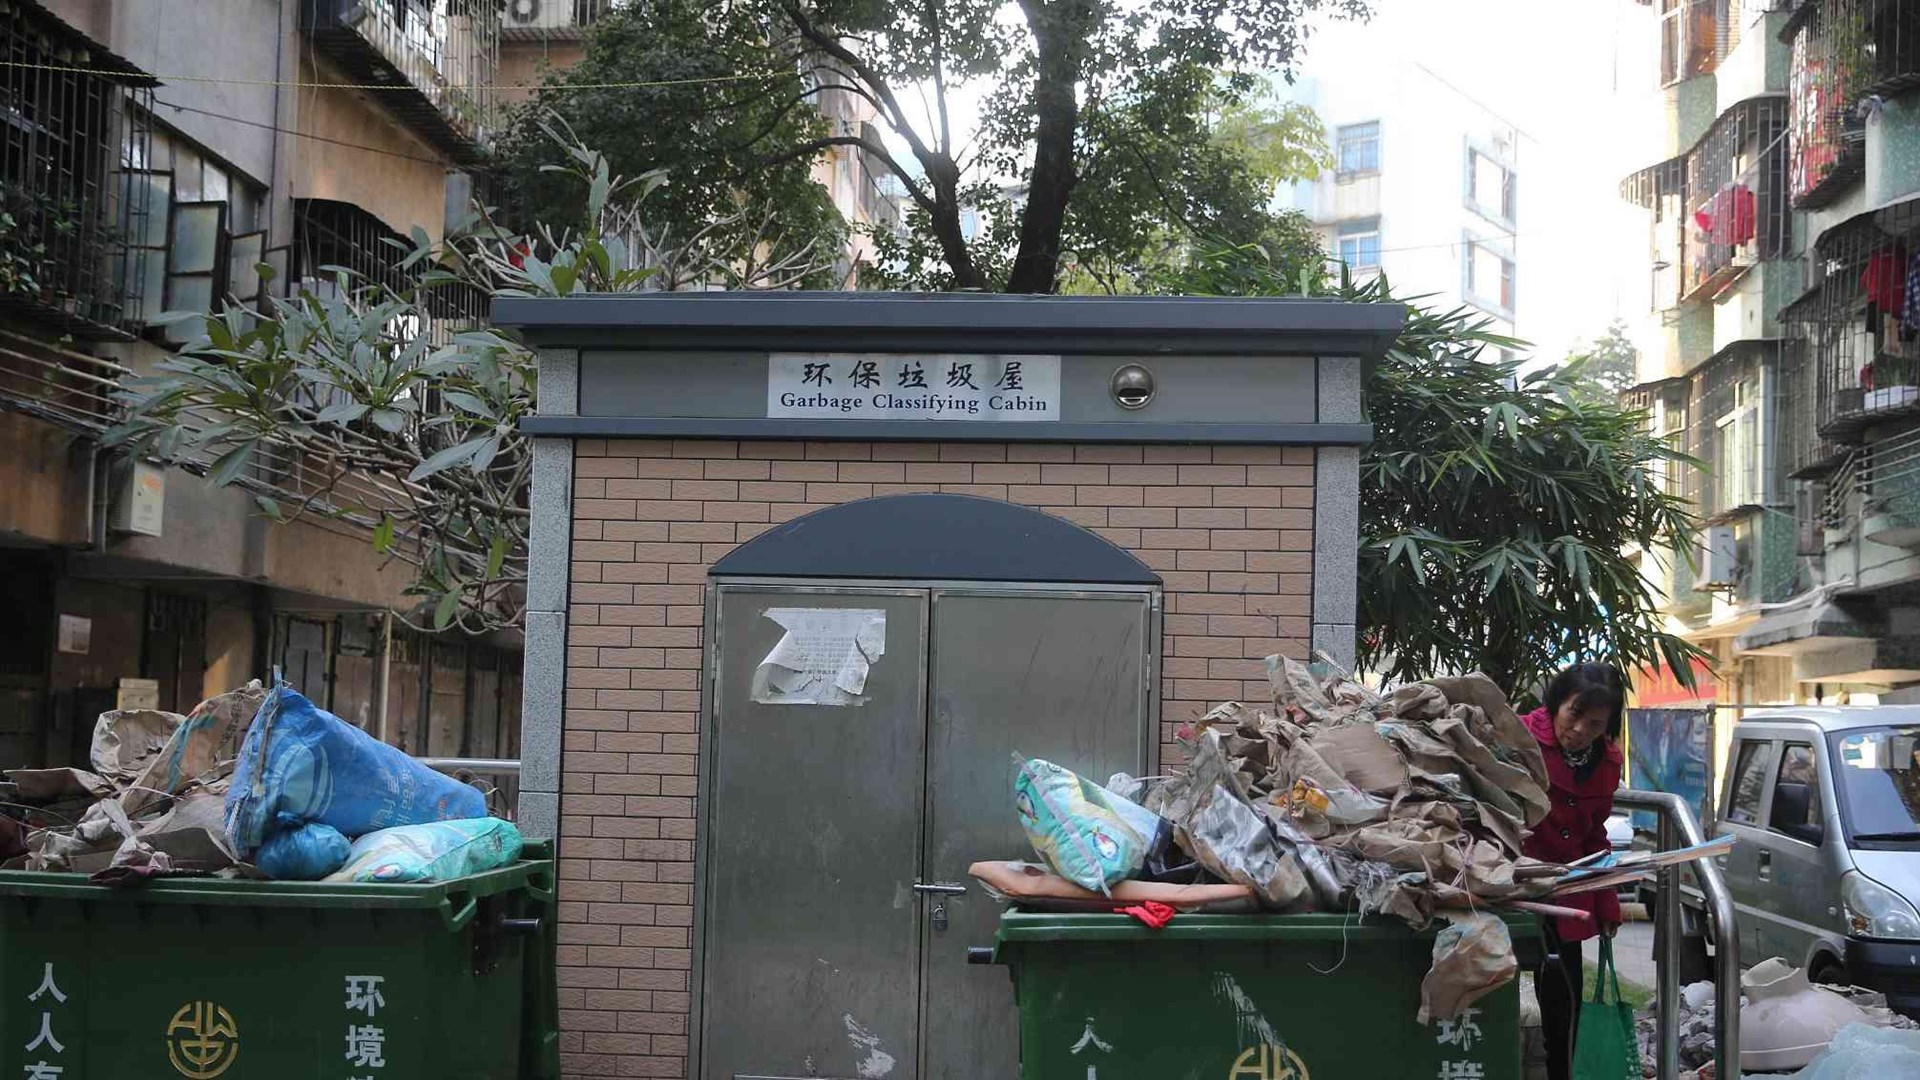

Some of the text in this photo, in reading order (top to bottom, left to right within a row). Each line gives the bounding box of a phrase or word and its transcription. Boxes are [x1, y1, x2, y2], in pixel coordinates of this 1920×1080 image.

[801, 360, 1024, 390] 环保垃圾屋
[780, 392, 1047, 414] Garbage Classifying Cabin
[345, 975, 386, 1080] 环境
